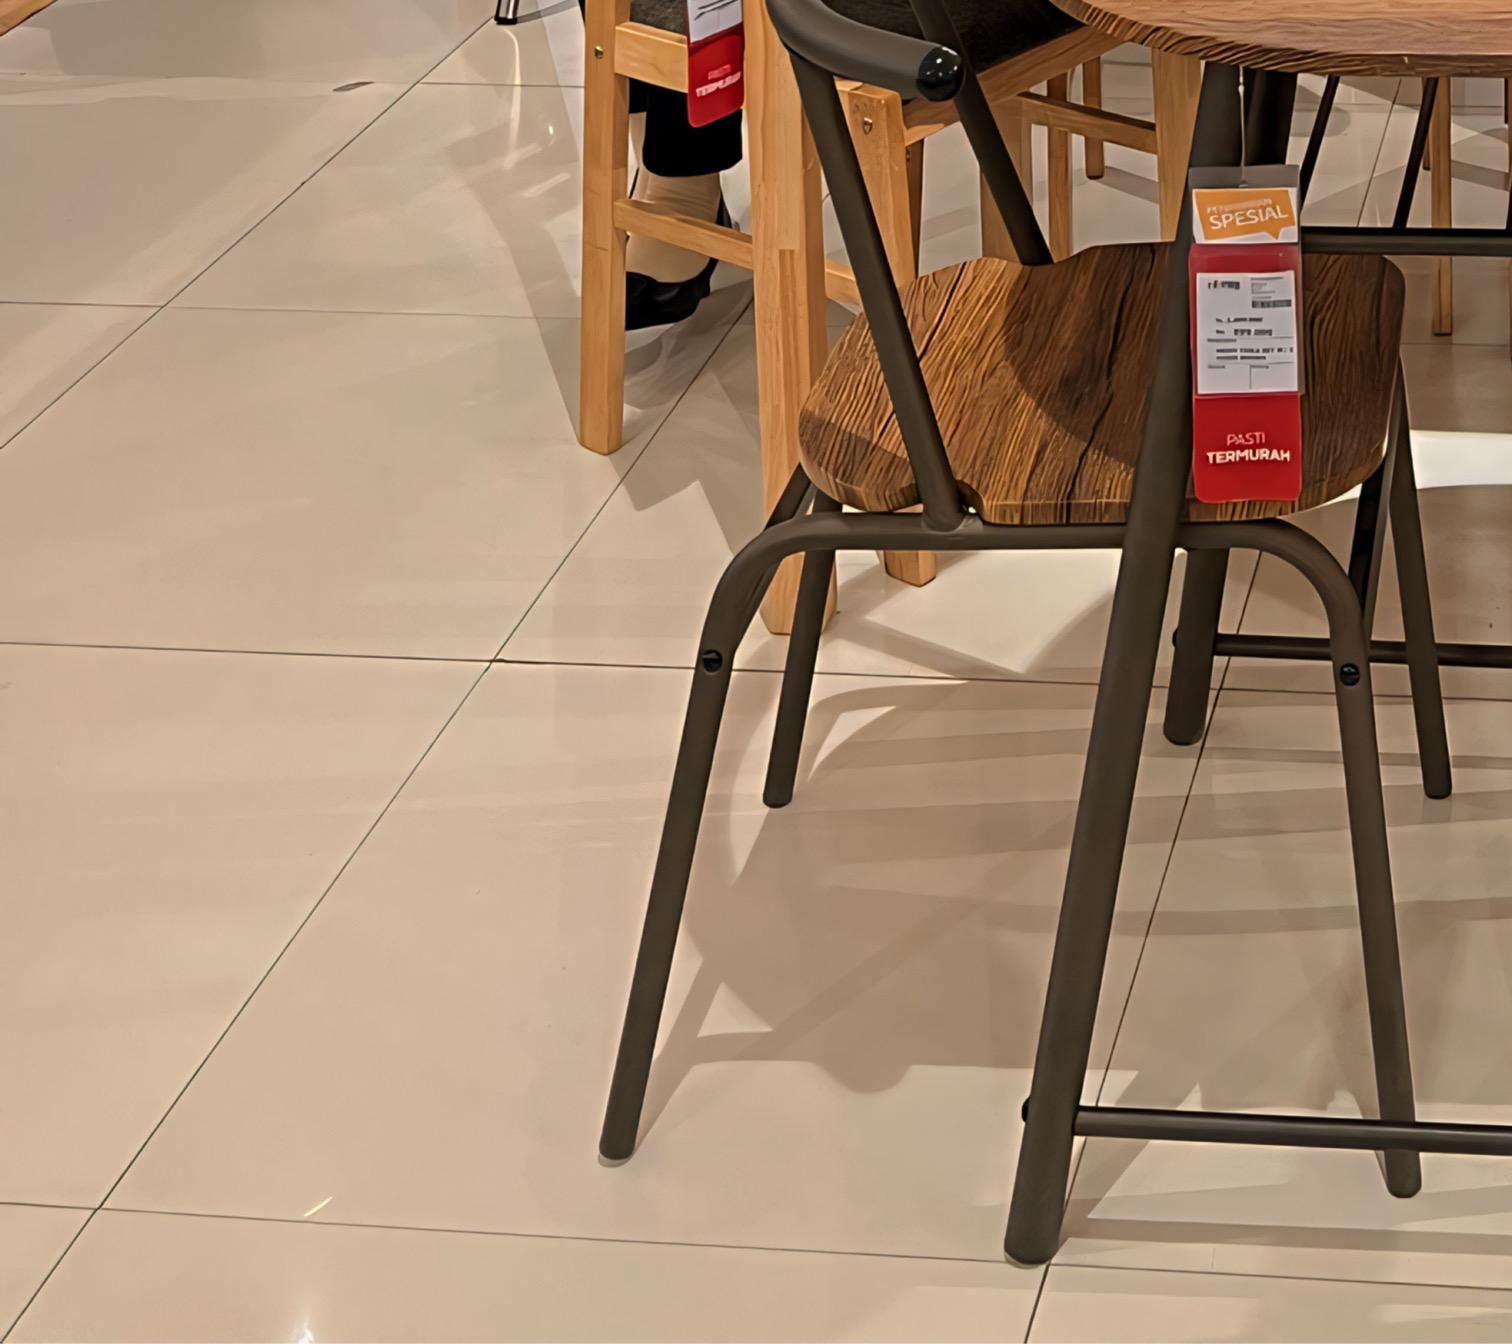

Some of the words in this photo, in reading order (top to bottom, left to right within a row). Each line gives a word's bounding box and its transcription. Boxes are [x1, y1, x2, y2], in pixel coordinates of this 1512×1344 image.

[1209, 204, 1289, 230] SPESIAL
[1226, 431, 1266, 447] PASTI
[1206, 447, 1291, 465] TERMURAH
